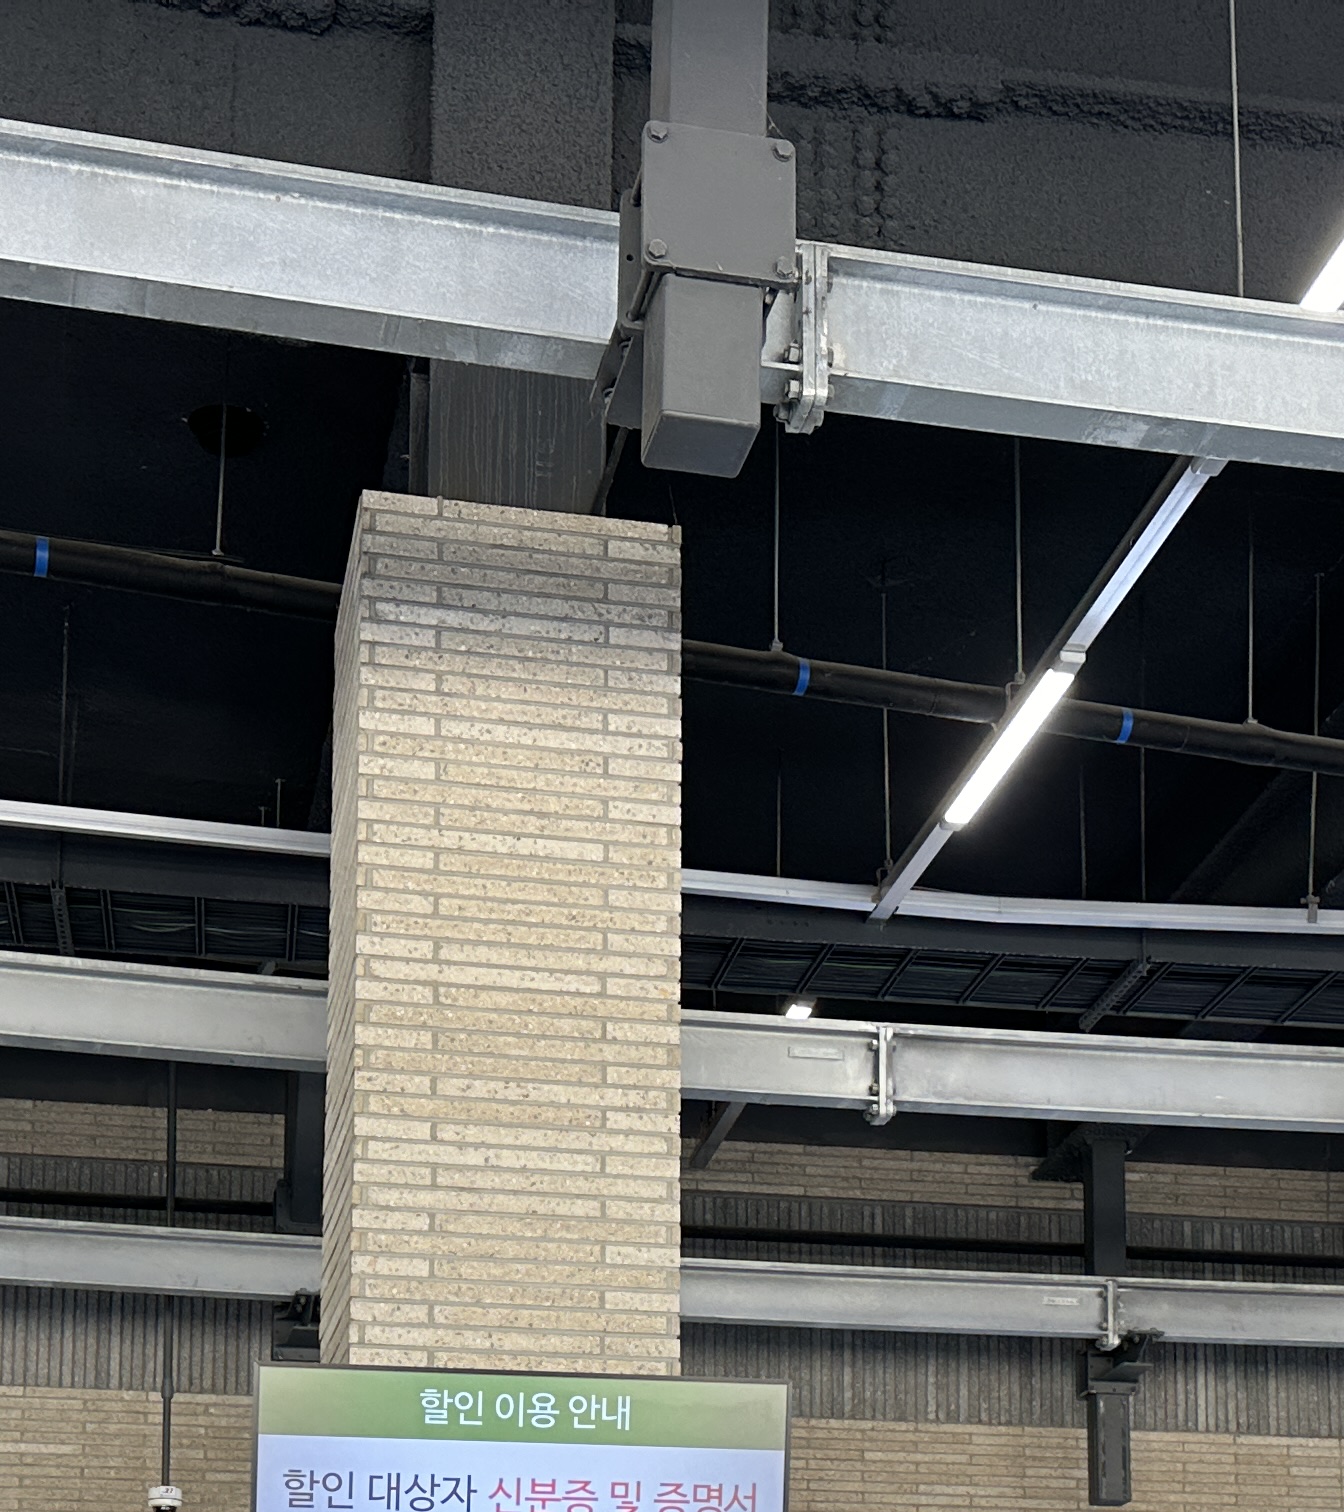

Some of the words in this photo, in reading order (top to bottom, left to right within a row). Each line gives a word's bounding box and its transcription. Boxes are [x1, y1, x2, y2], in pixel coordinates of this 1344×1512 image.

[419, 1388, 484, 1426] 할인
[495, 1392, 560, 1429] 이용
[568, 1394, 632, 1431] 안내
[282, 1468, 354, 1510] 할인
